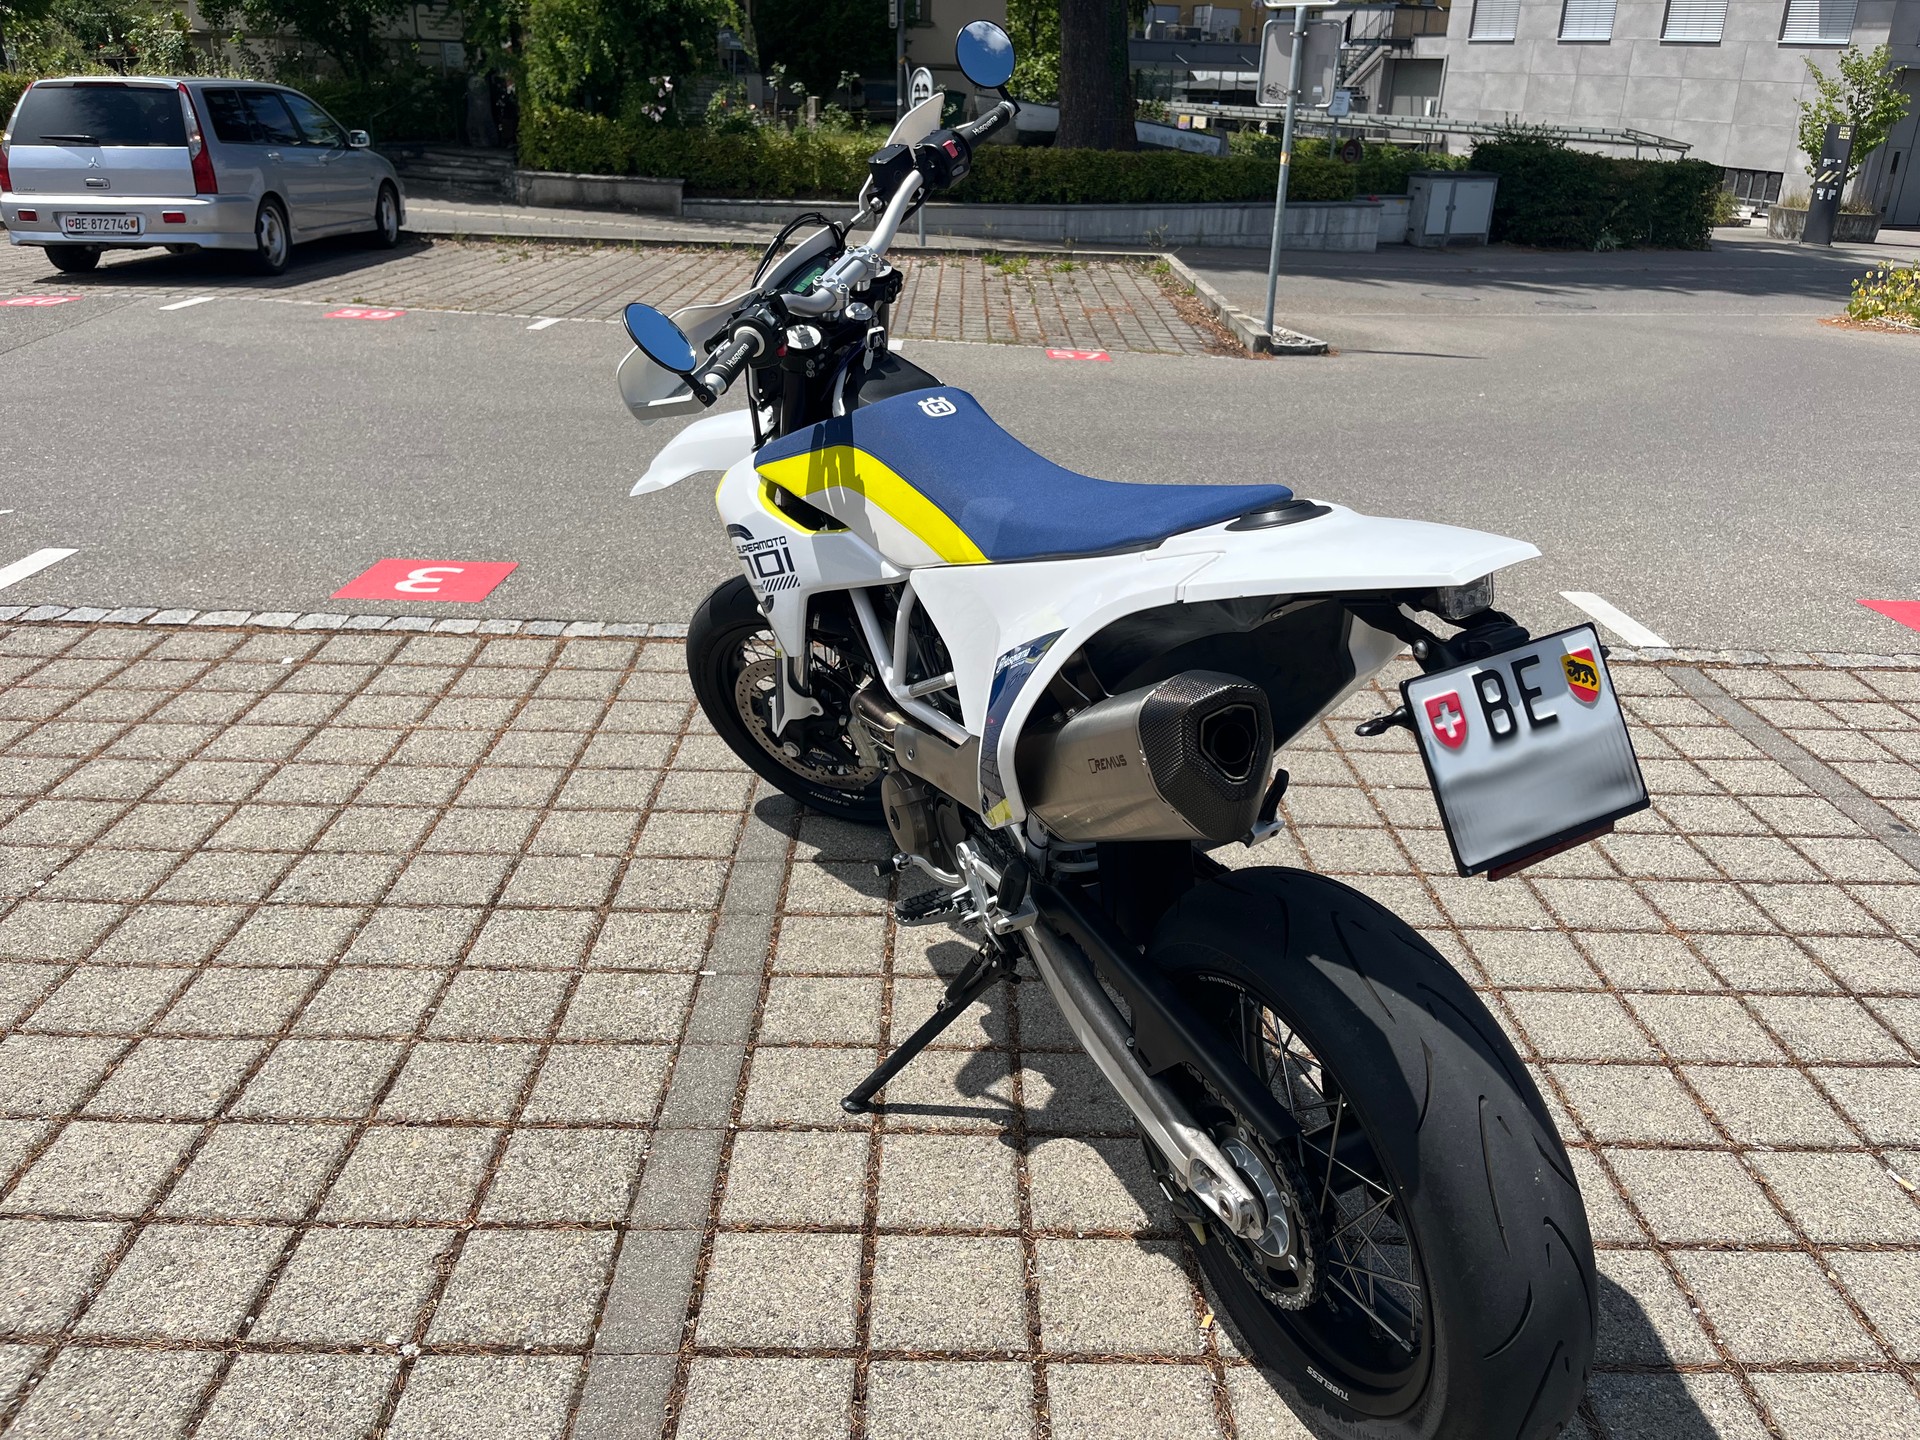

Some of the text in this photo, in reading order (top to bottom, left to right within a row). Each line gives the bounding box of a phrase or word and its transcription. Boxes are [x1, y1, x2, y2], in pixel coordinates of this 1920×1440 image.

[394, 566, 465, 593] 3
[1471, 654, 1559, 741] BE
[1094, 754, 1127, 771] REMUS
[1306, 1365, 1349, 1401] TUBELESS
